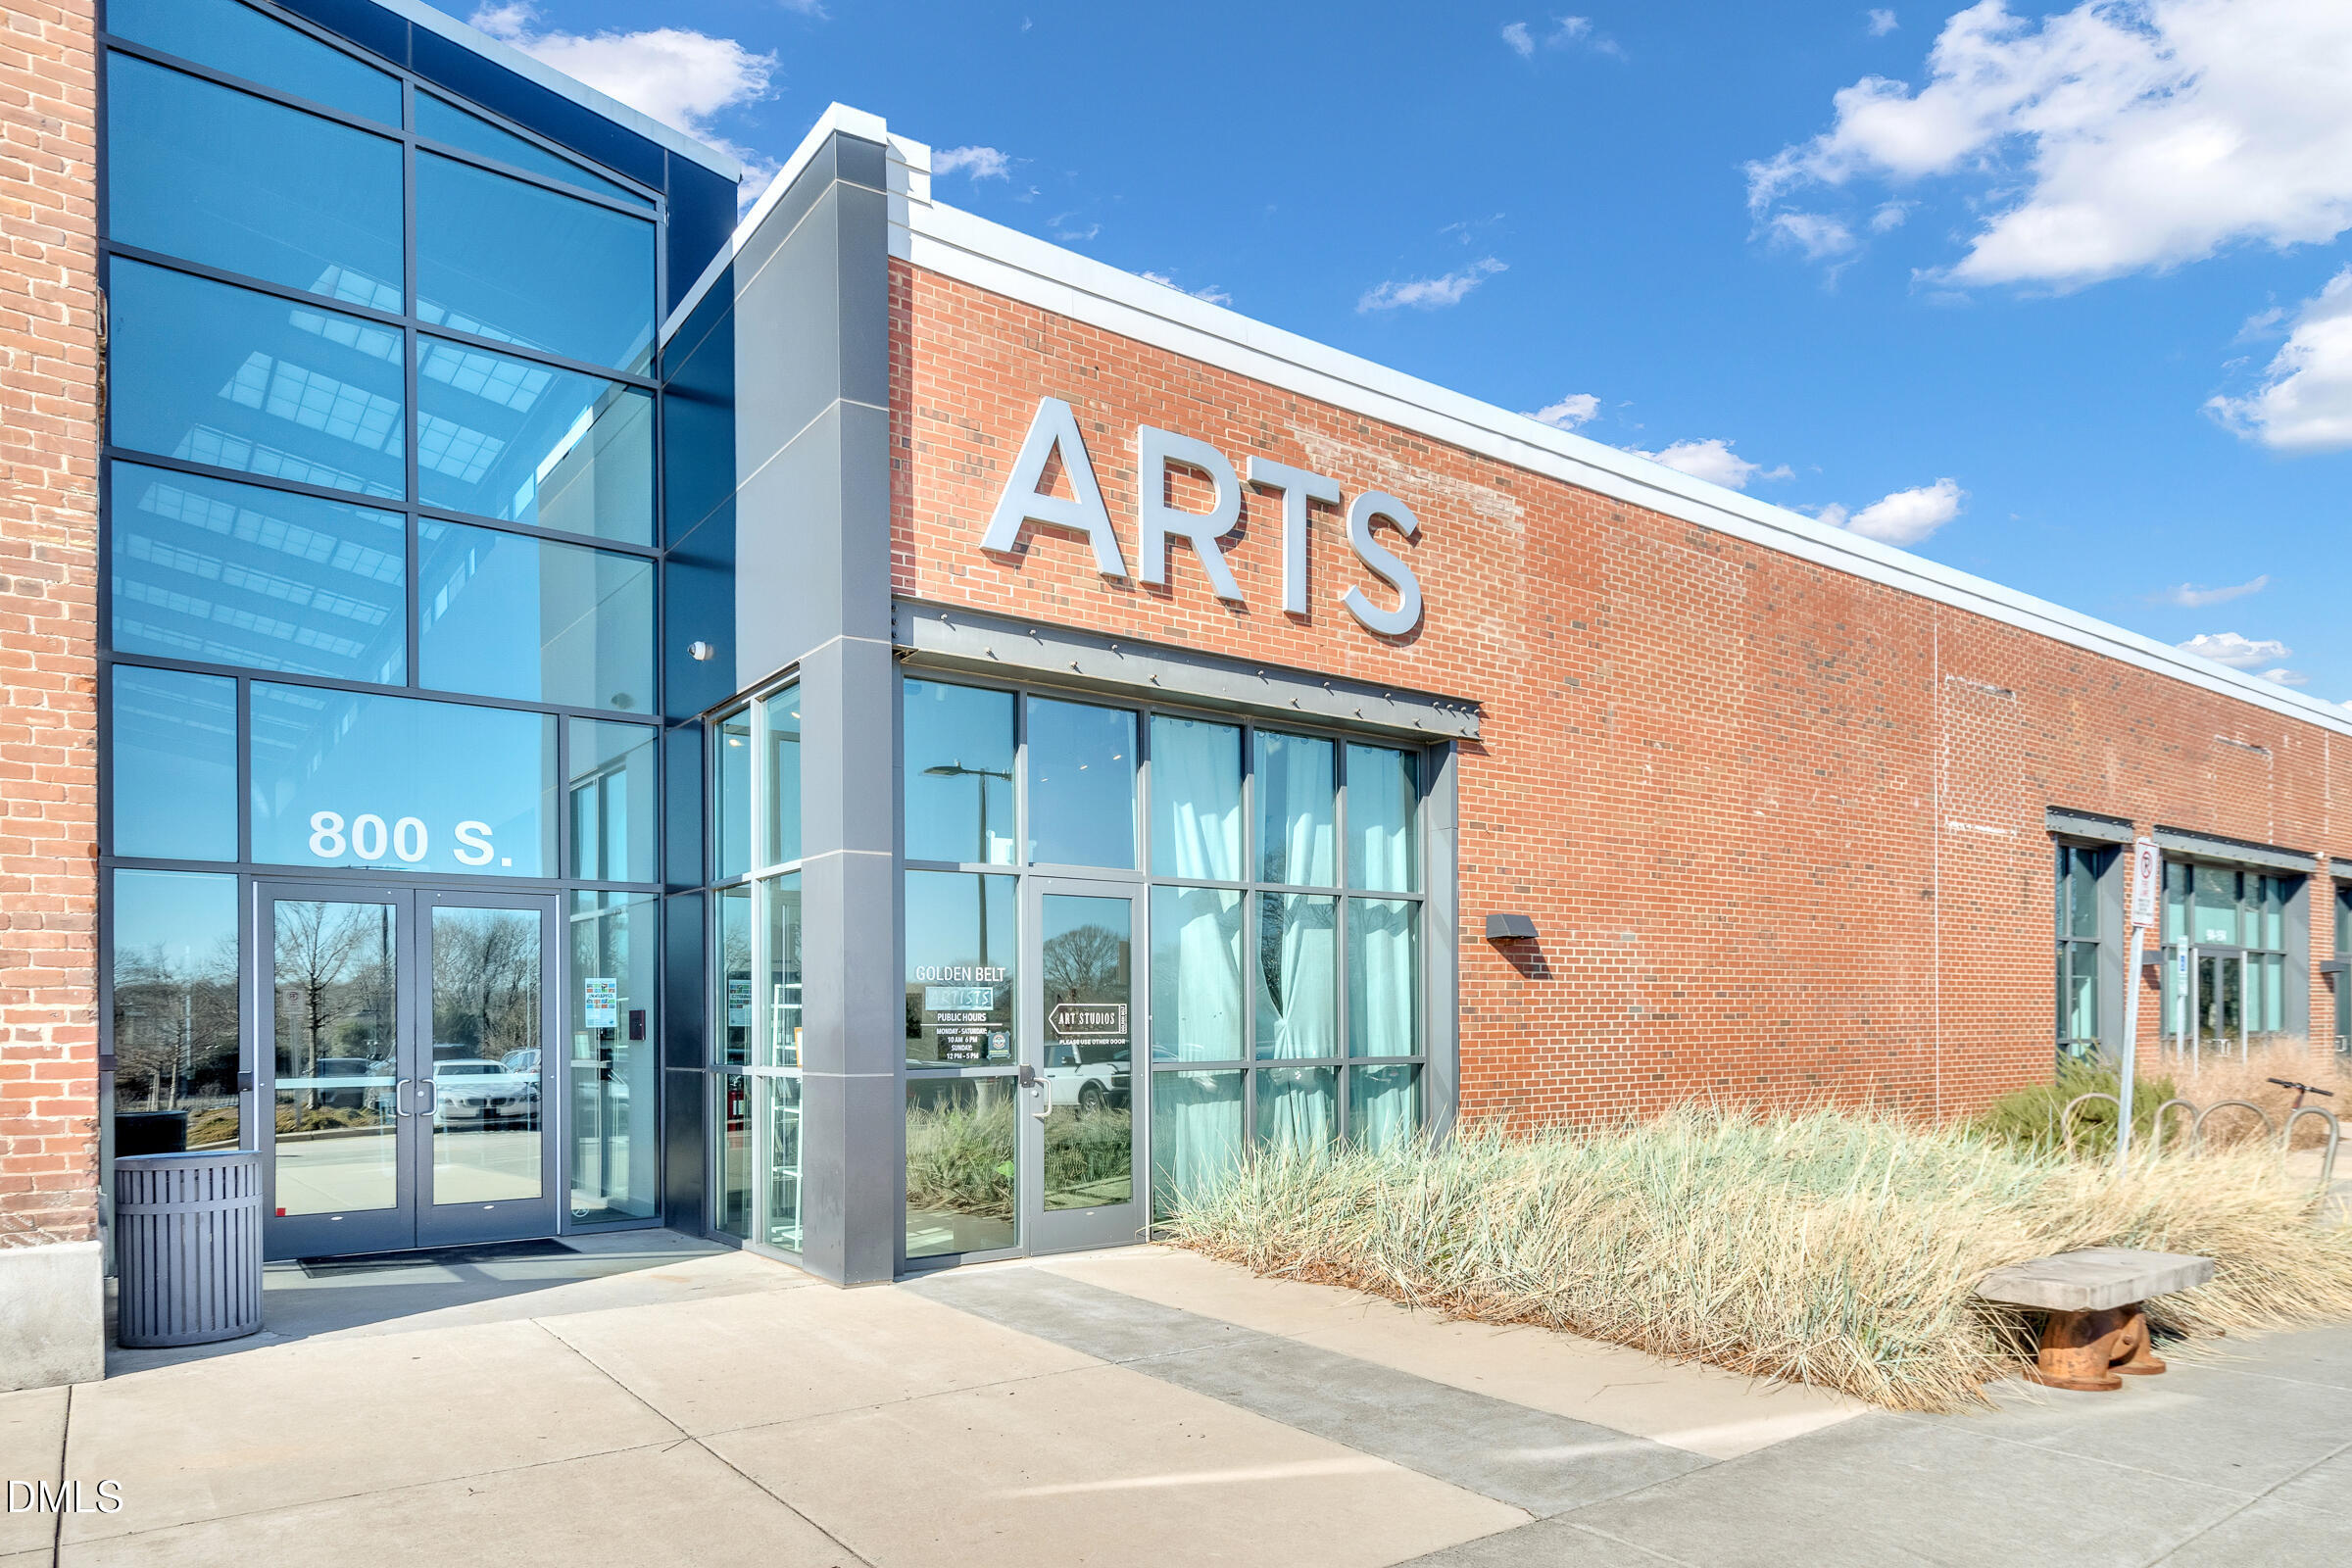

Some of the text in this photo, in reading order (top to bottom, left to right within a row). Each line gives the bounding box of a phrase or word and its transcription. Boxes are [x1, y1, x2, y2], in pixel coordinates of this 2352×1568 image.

[979, 395, 1422, 637] ARTS
[309, 810, 512, 867] 800 S.
[916, 965, 1005, 982] GOLDEN BELT
[937, 1012, 987, 1021] PUBLIC HOURS
[1058, 1011, 1115, 1025] ART STUDIOS
